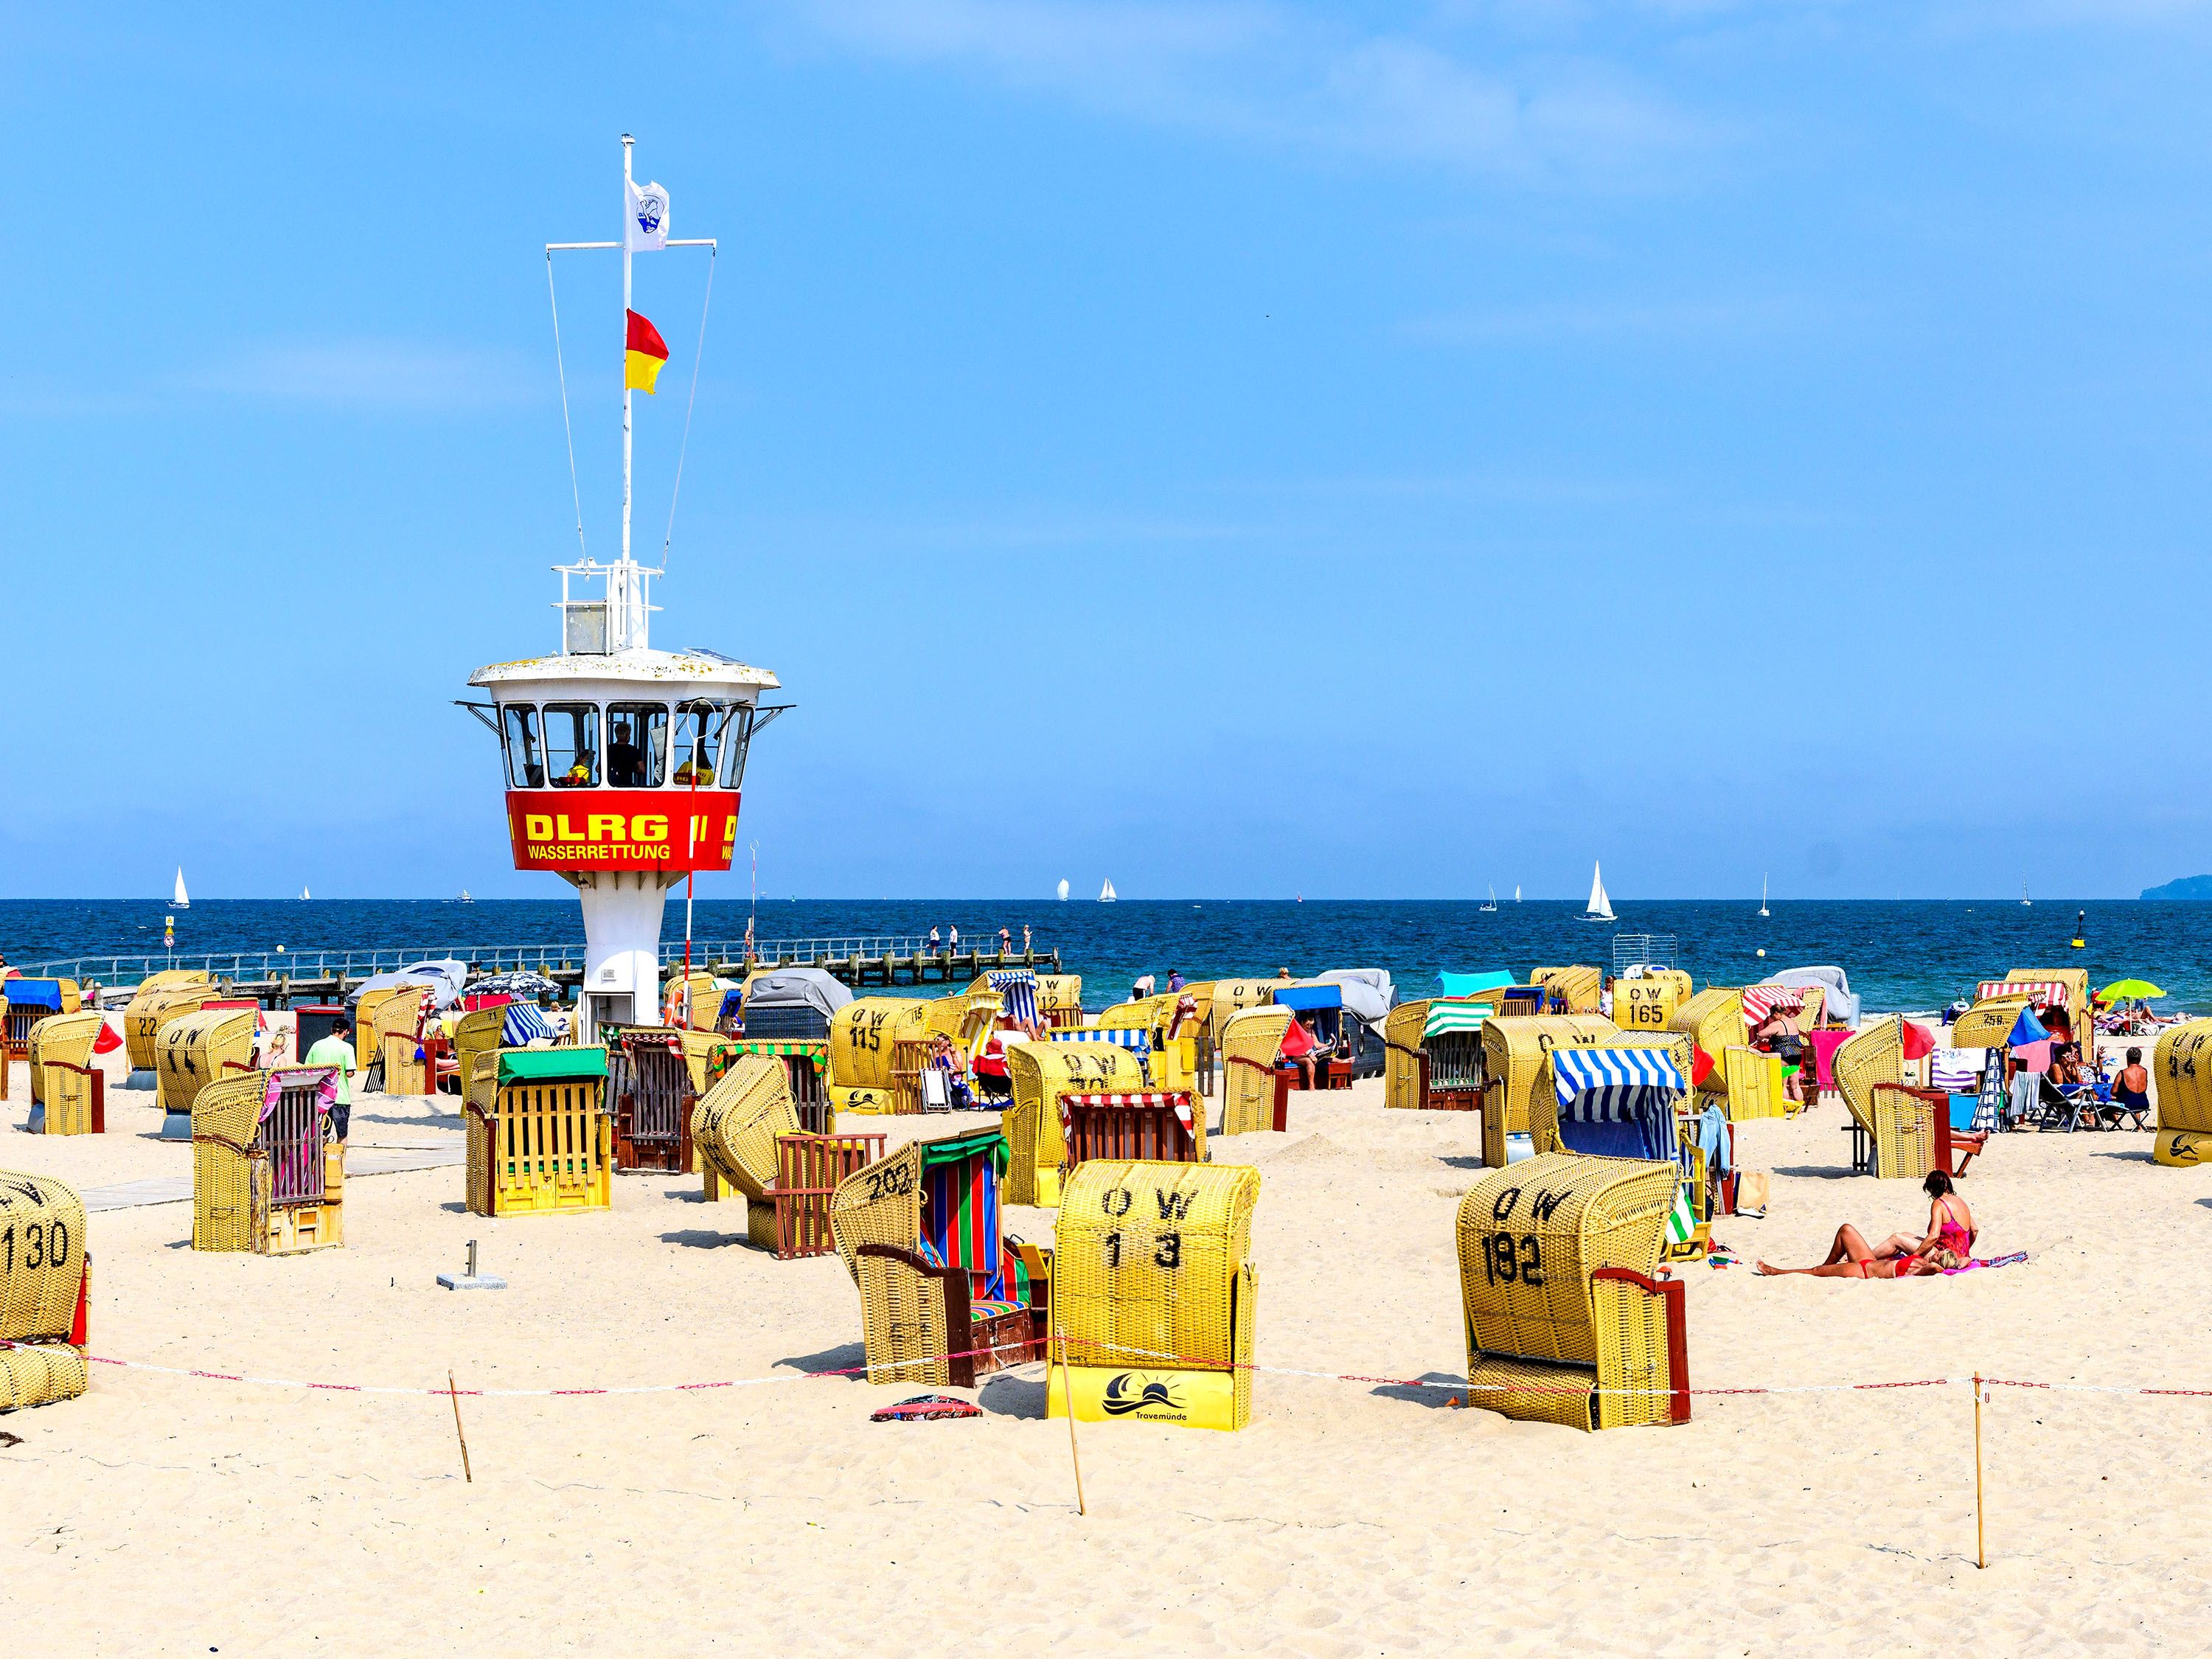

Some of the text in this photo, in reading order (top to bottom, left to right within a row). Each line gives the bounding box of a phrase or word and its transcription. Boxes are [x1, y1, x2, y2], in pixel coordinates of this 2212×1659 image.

[526, 814, 669, 841] DLRG
[528, 844, 671, 860] WASSERRETTUNG
[139, 1016, 157, 1037] 22
[1630, 1005, 1663, 1024] 165
[849, 1026, 881, 1051] 115
[866, 1162, 913, 1200] 202
[1, 1220, 69, 1275] 130
[1481, 1231, 1545, 1287] 182
[1135, 1411, 1188, 1421] Travemünde
